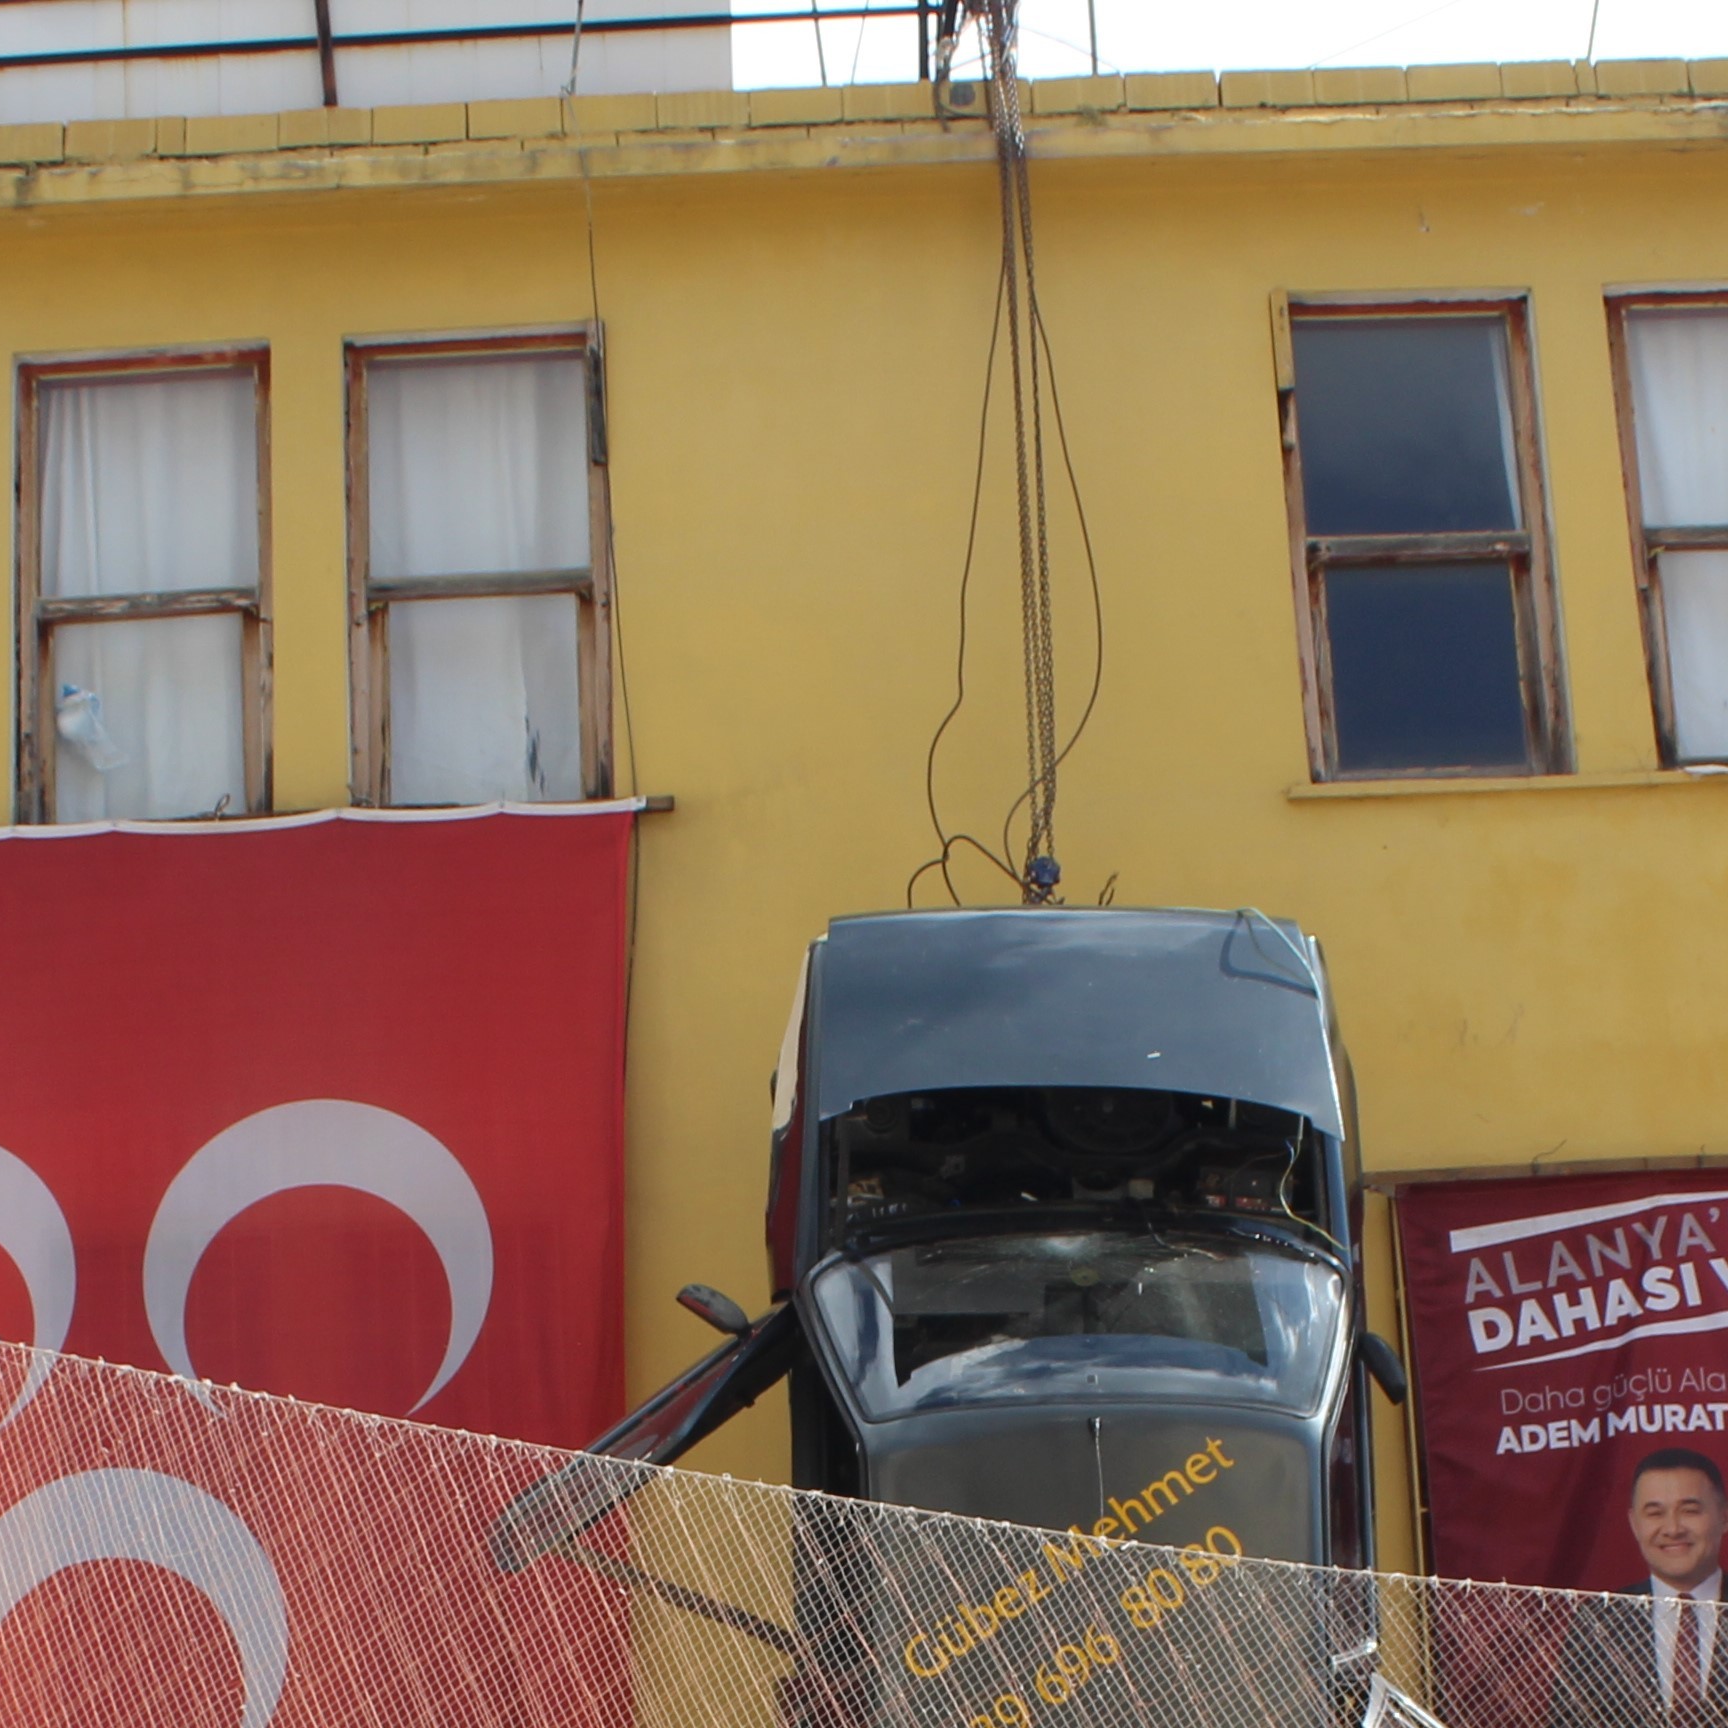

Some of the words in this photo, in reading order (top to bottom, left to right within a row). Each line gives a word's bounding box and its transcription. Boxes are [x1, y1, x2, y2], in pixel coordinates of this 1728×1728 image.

[1468, 1262, 1702, 1354] DAHASI
[1496, 1417, 1601, 1455] ADEM
[1608, 1403, 1728, 1437] MURAT
[1501, 1386, 1585, 1416] Daha
[1593, 1368, 1672, 1411] güçlü
[904, 1567, 1052, 1678] Gübez
[1040, 1436, 1235, 1584] Mehmet
[1035, 1624, 1120, 1706] 696
[1122, 1568, 1186, 1630] 80
[1180, 1526, 1244, 1589] 80
